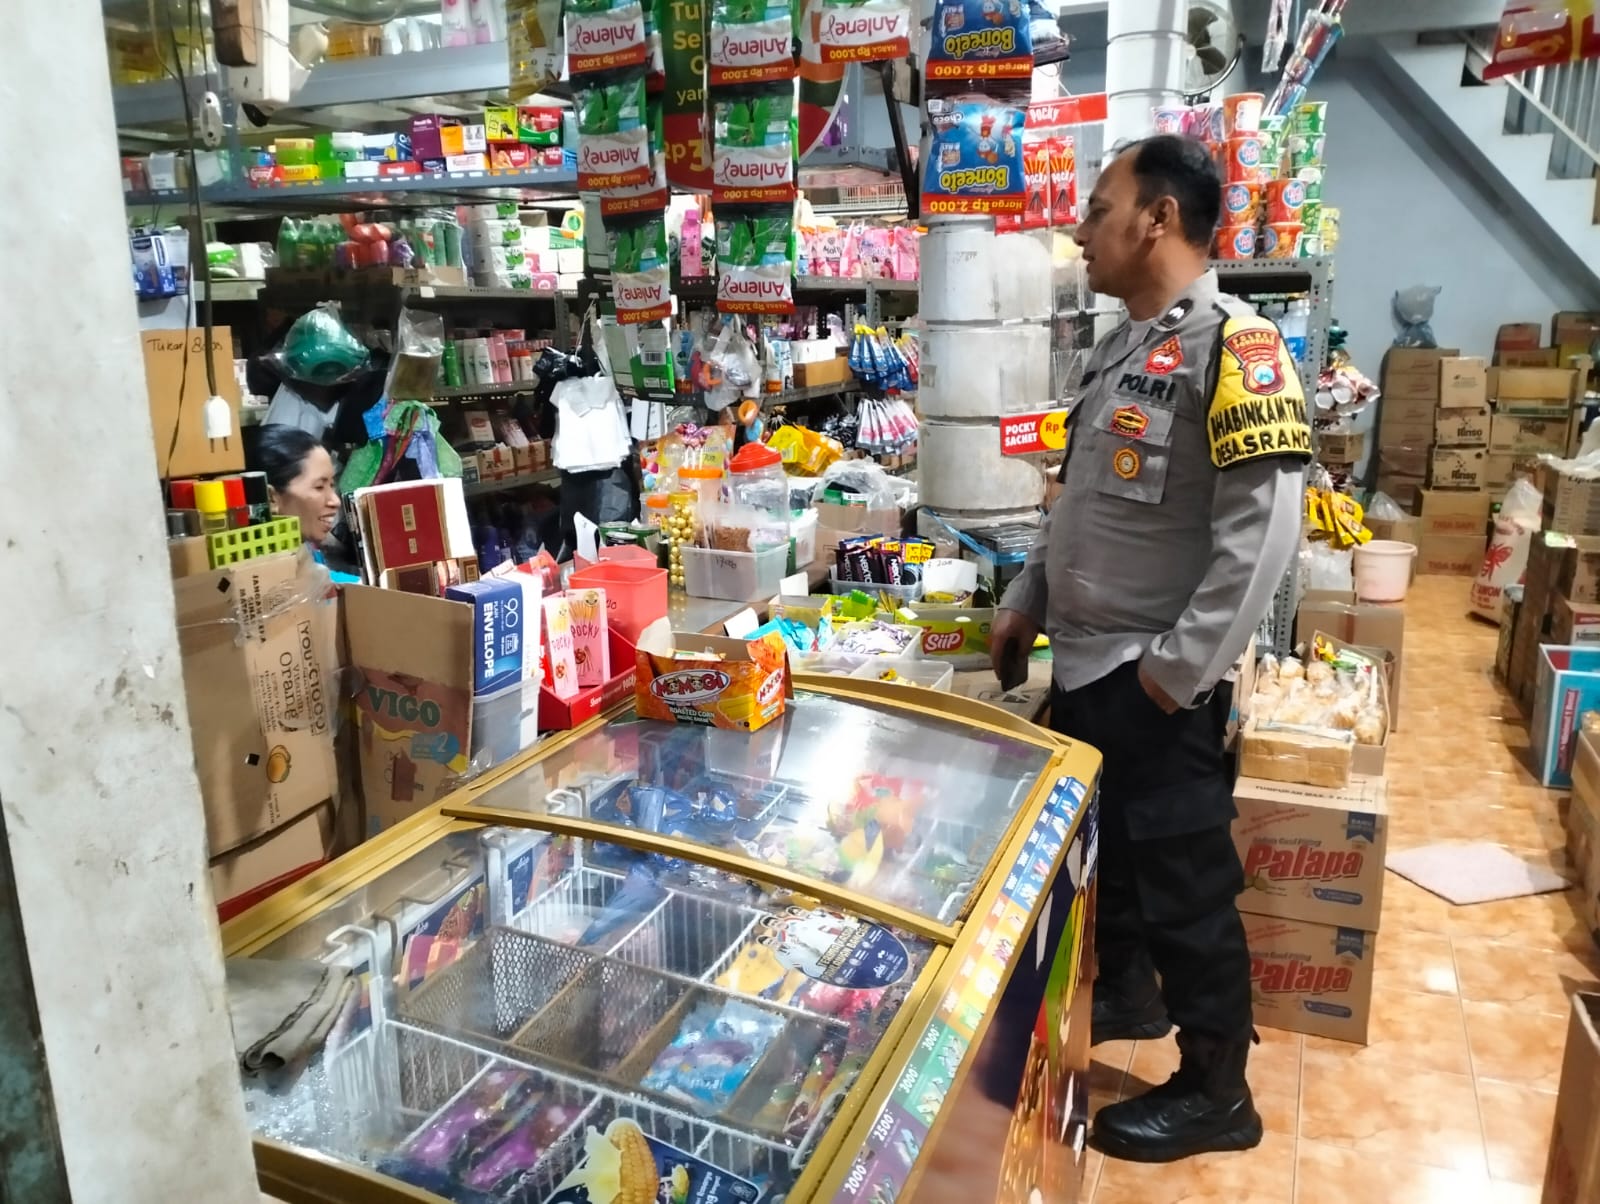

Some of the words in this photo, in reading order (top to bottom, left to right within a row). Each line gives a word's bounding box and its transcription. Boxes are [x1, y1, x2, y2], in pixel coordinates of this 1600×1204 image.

[836, 15, 900, 35] Anlene
[582, 24, 636, 44] Anlene
[729, 37, 788, 56] Anlene
[945, 28, 1015, 58] Boneeto
[602, 54, 615, 64] Rp
[857, 46, 872, 57] Rp
[750, 68, 762, 77] Rp
[935, 65, 974, 76] 2.000
[976, 63, 996, 75] Rp
[1030, 106, 1061, 122] POCKY
[592, 149, 640, 165] Anlene
[729, 162, 787, 179] Anlene
[941, 167, 1009, 190] Boneeto
[612, 175, 622, 185] Rp
[750, 189, 763, 198] Rp
[930, 202, 969, 213] 2.000
[972, 200, 991, 212] Rp
[624, 284, 661, 301] Anlene
[729, 281, 784, 297] Anlene
[751, 303, 764, 311] Rp
[1118, 373, 1176, 400] POLRI
[1006, 422, 1036, 435] POCKY
[1046, 423, 1059, 434] Rp
[1457, 427, 1483, 437] Rinso
[1006, 433, 1037, 447] SACHET
[1451, 469, 1477, 481] Rinso
[504, 597, 518, 628] 90
[571, 622, 600, 639] POCKY
[483, 602, 495, 678] ENVELOPE
[280, 651, 299, 720] Orang
[368, 686, 441, 728] VIGO
[670, 707, 697, 717] ROASTED
[697, 710, 715, 719] CORN
[1245, 844, 1363, 882] Palapa
